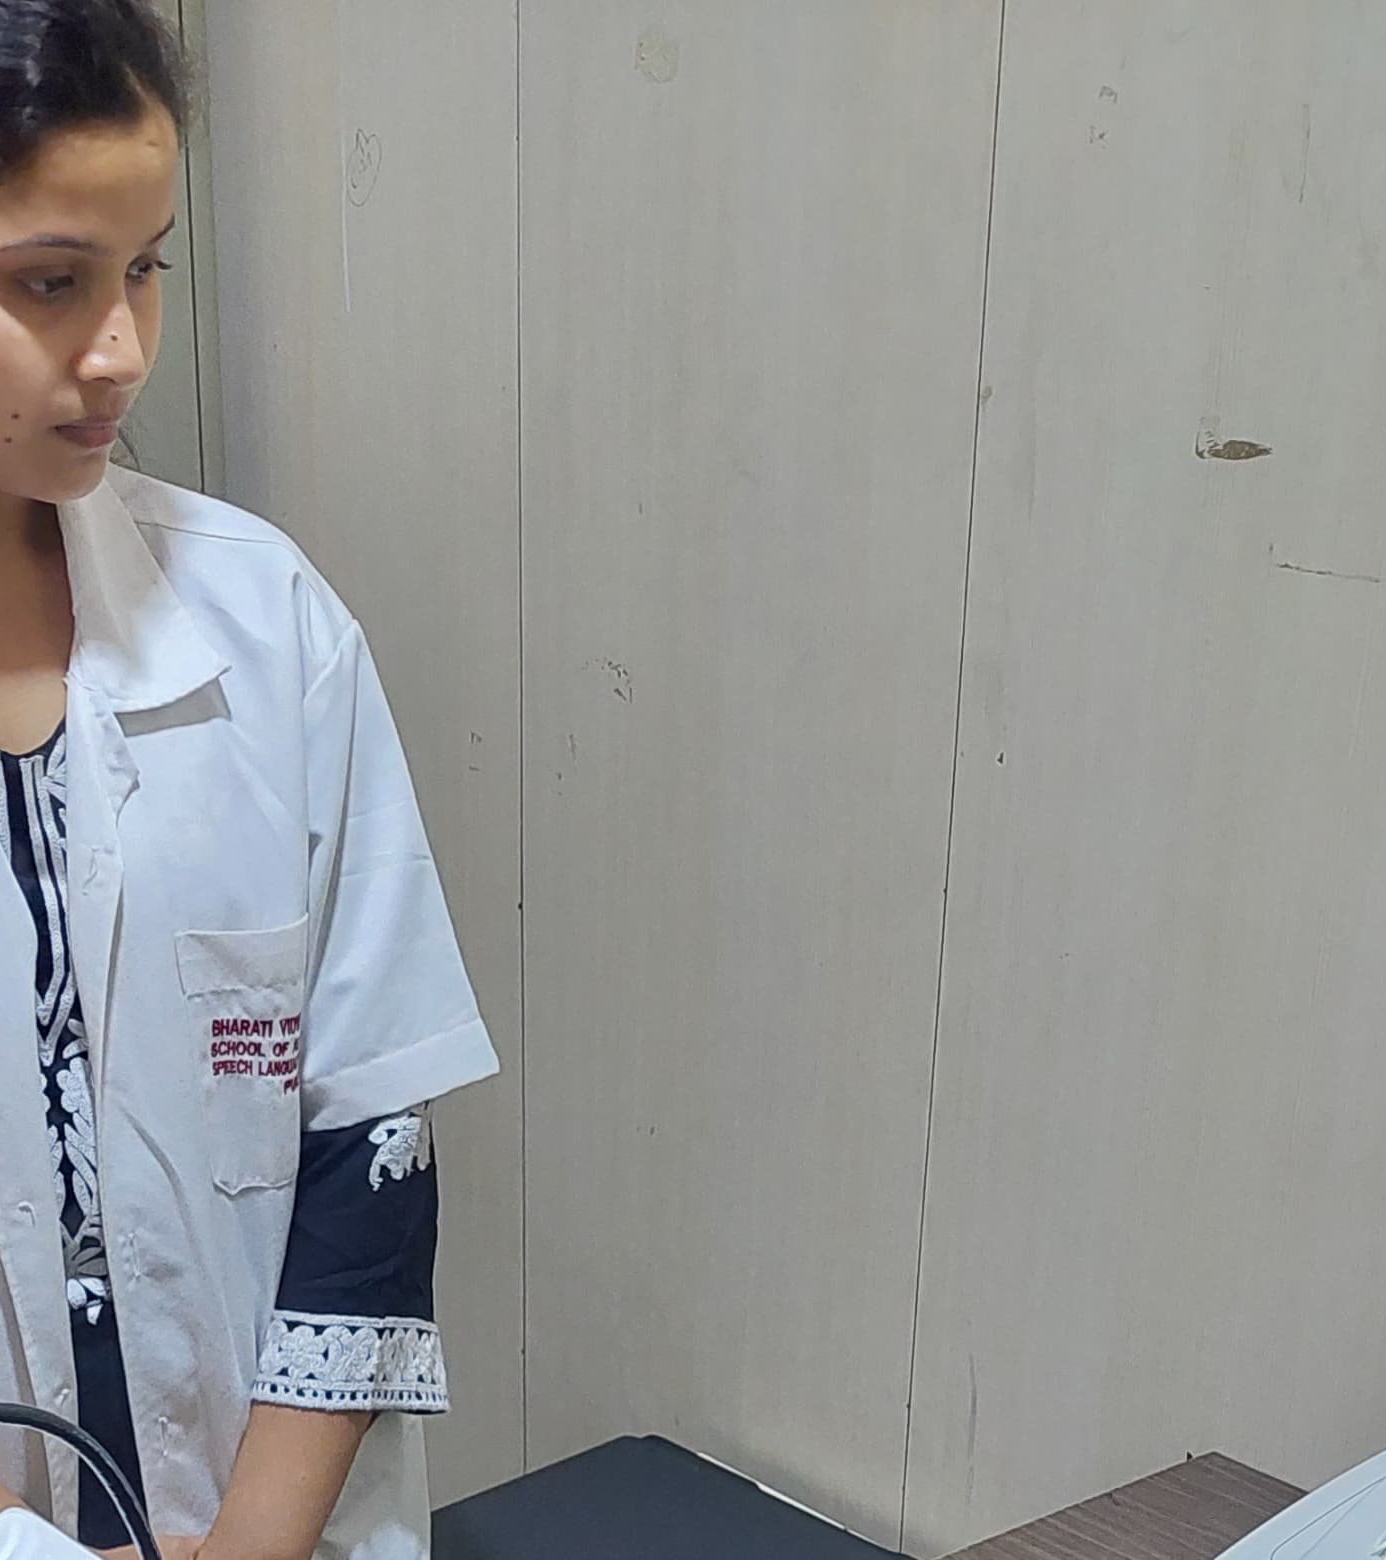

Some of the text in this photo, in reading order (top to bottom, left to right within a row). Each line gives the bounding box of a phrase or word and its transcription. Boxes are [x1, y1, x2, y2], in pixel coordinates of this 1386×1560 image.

[212, 1018, 273, 1038] BHARATI
[211, 1040, 266, 1057] SCHOOL
[273, 1041, 289, 1057] OF
[212, 1059, 253, 1076] SPEECH
